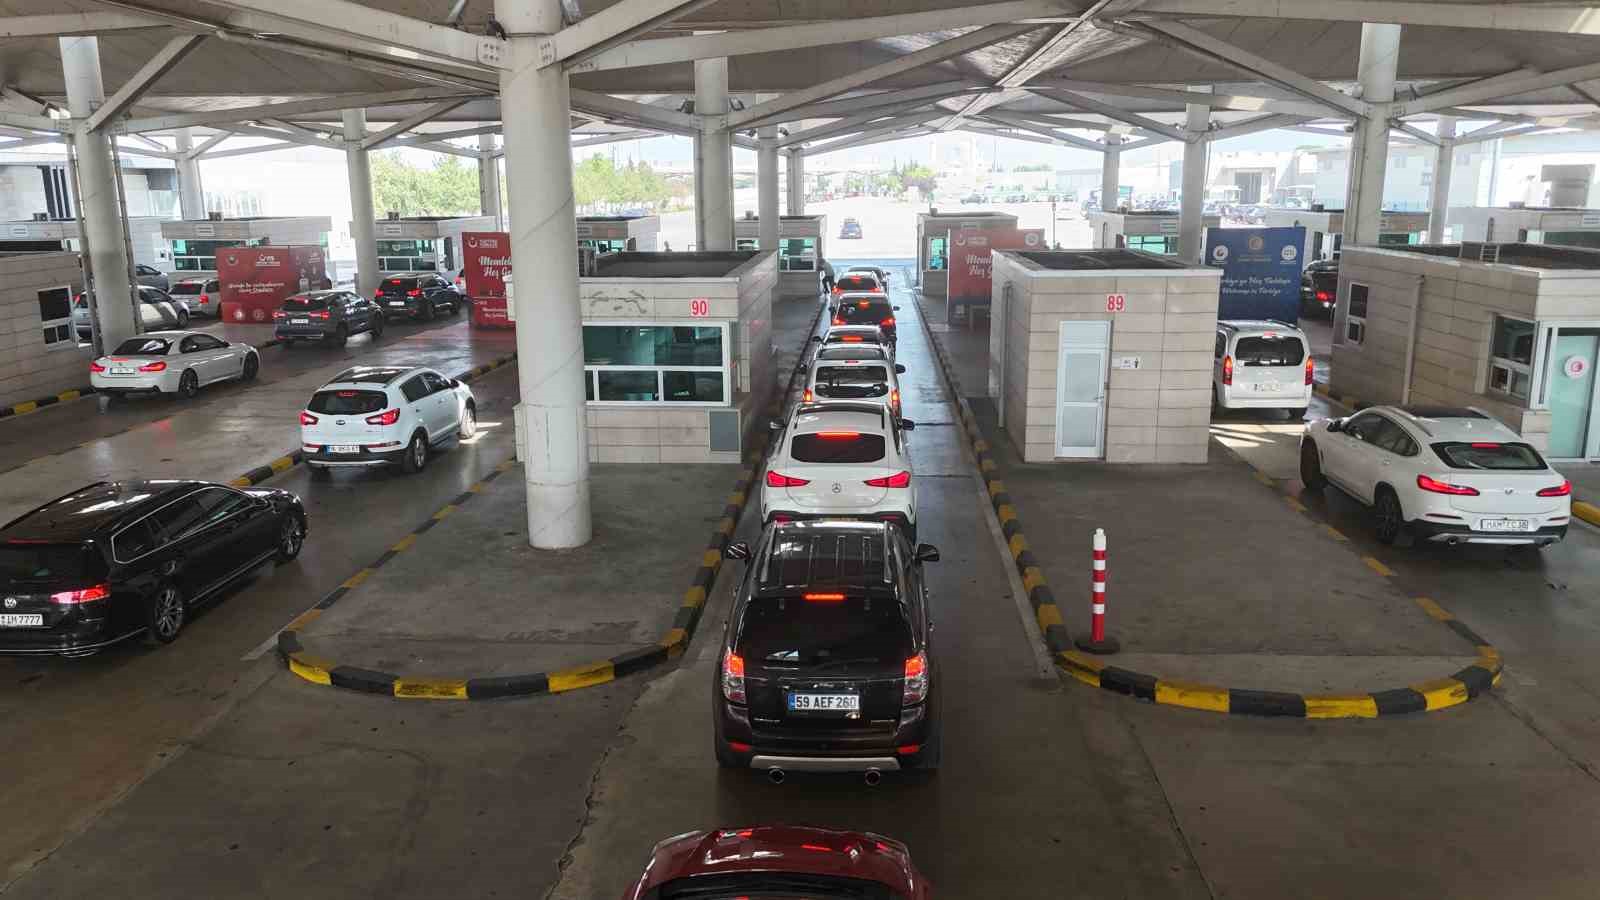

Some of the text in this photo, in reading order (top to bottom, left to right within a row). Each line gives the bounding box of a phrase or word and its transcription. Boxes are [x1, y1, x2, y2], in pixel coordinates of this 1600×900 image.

[691, 300, 707, 316] 90
[1107, 295, 1124, 311] 89
[796, 696, 810, 708] 59
[814, 696, 834, 708] AEF
